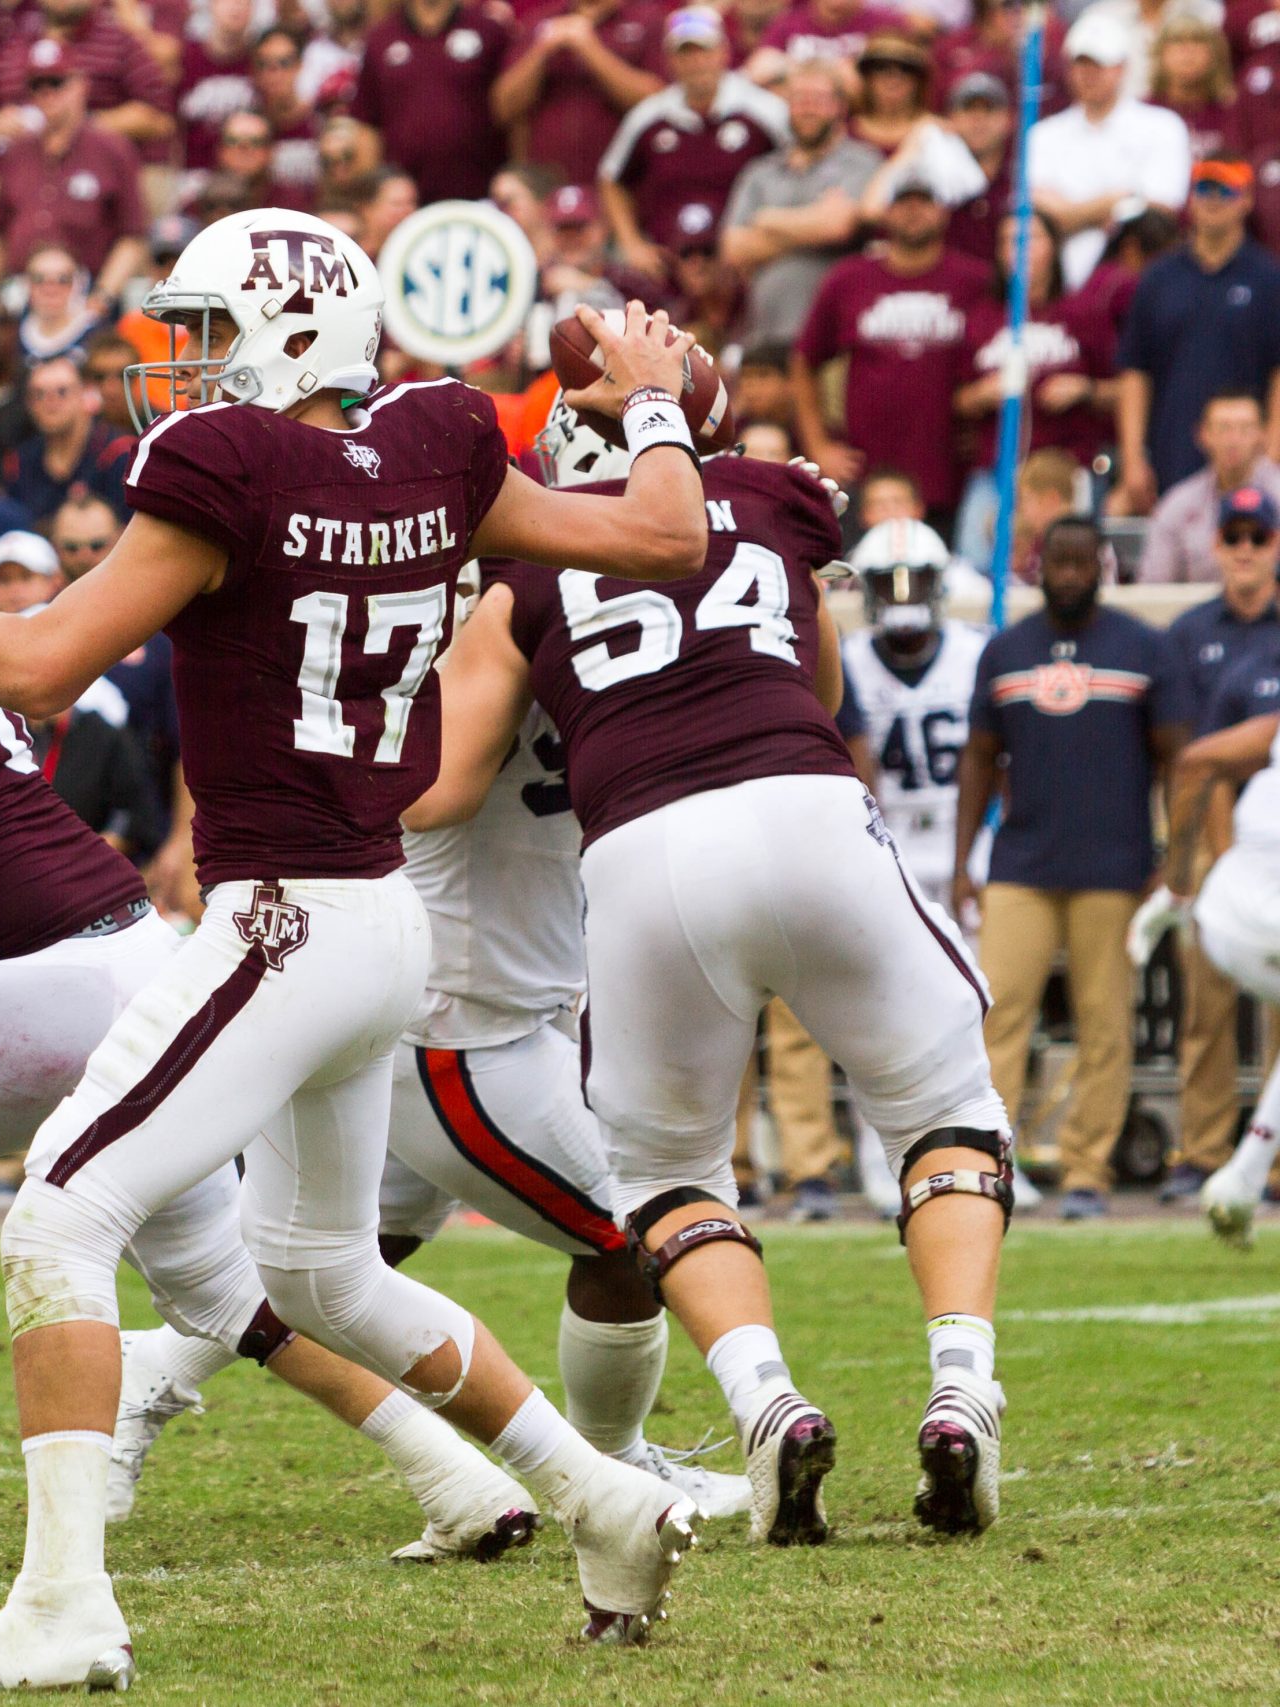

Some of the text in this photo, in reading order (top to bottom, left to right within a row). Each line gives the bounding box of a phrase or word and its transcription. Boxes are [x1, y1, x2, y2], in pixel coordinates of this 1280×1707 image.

[402, 222, 509, 338] SEC
[282, 506, 457, 565] STARKEL
[289, 583, 445, 763] 17
[558, 541, 801, 692] 54
[880, 710, 961, 791] 46
